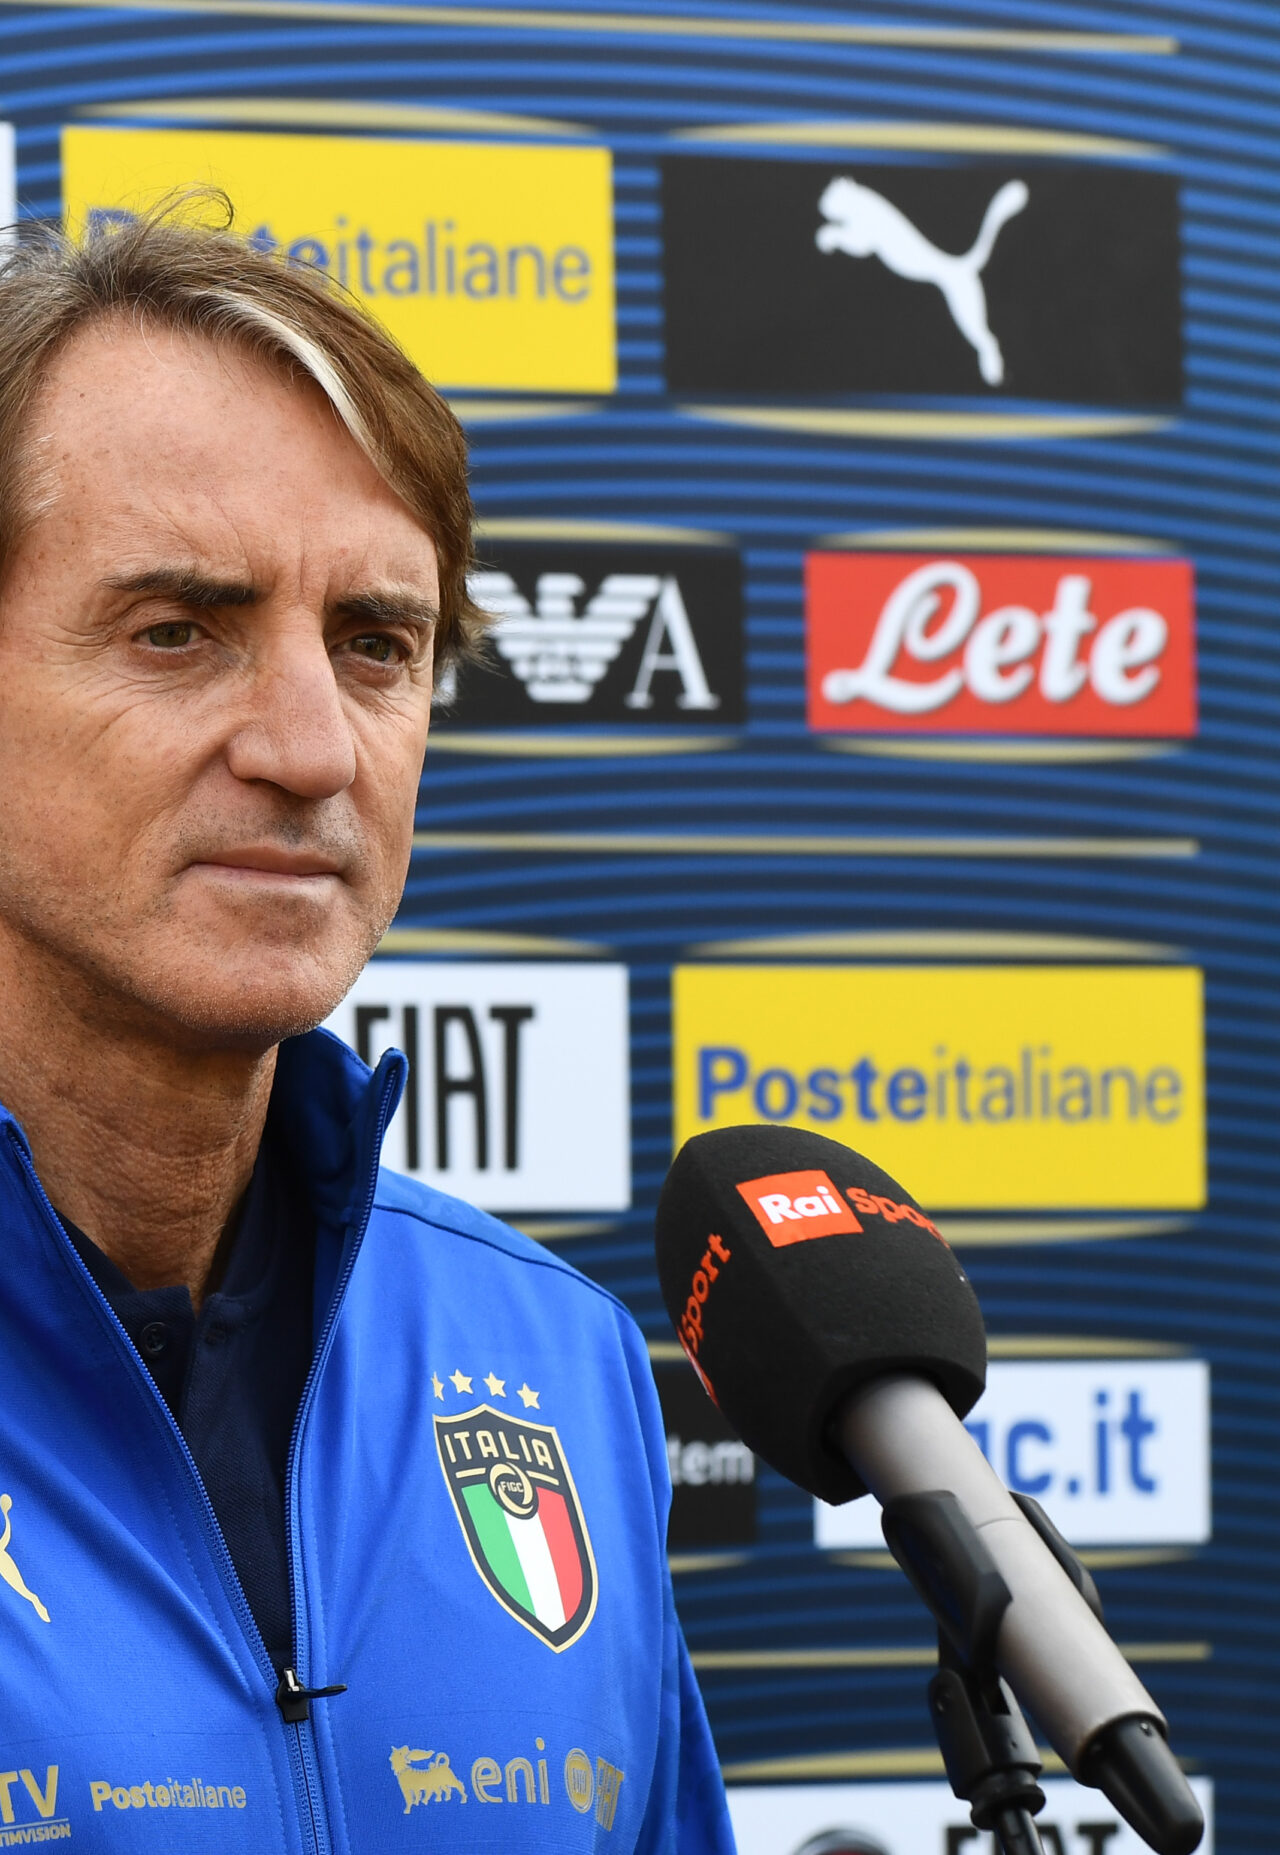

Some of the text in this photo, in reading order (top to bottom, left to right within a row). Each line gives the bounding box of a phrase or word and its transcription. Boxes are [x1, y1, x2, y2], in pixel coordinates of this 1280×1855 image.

[88, 208, 592, 303] eitaliane
[821, 562, 1169, 714] Lete
[697, 1045, 1184, 1124] Posteitaliane
[758, 1185, 842, 1224] Rai
[444, 1430, 555, 1471] ITALIA
[500, 1480, 524, 1493] FIGC
[89, 1777, 247, 1812] Posteitaliane
[471, 1737, 550, 1805] eni
